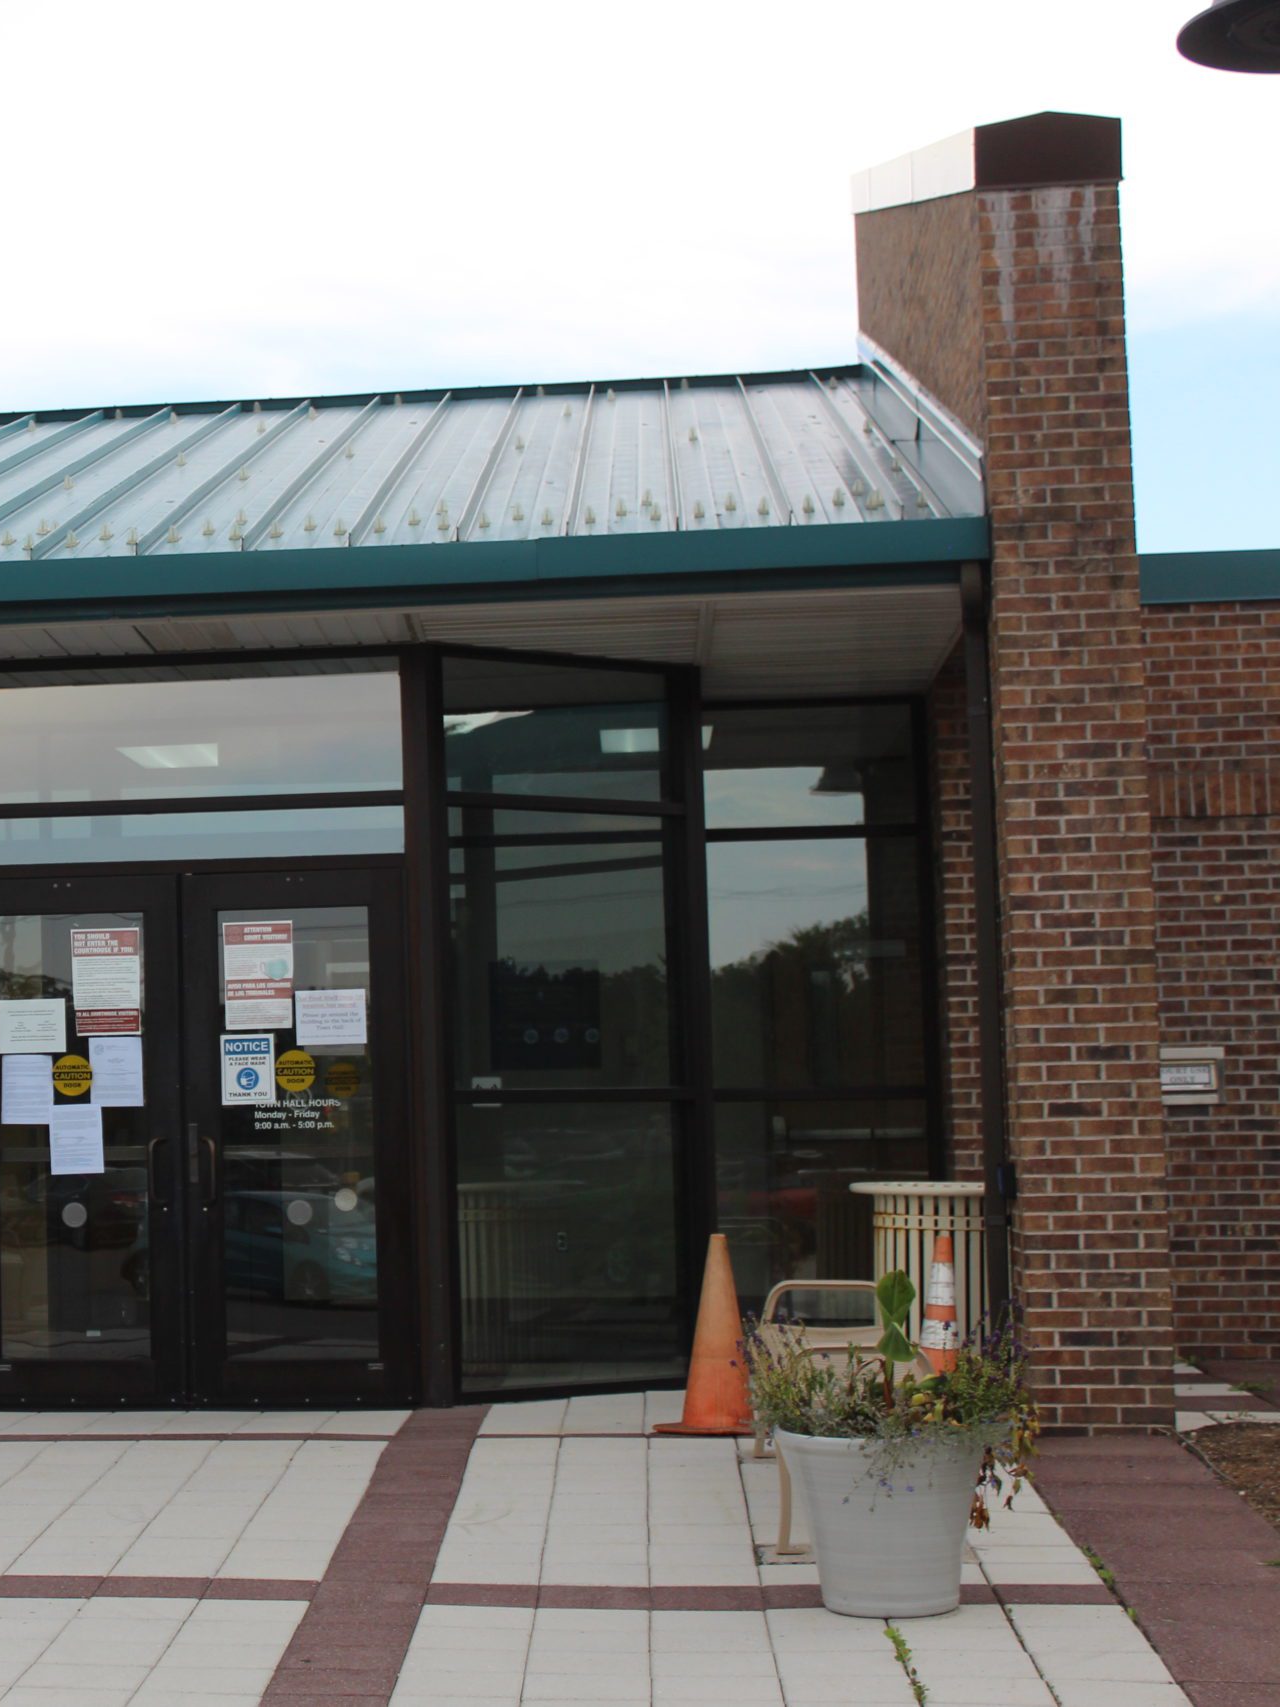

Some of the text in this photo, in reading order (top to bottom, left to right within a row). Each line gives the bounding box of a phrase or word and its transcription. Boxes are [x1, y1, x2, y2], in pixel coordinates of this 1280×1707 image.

[225, 1041, 268, 1052] NOTICE
[283, 1099, 307, 1108] HALL
[308, 1099, 341, 1107] HOURS
[254, 1111, 287, 1120] Monday
[294, 1110, 320, 1119] Friday
[254, 1122, 272, 1130] 9:00
[317, 1122, 335, 1130] p.m.
